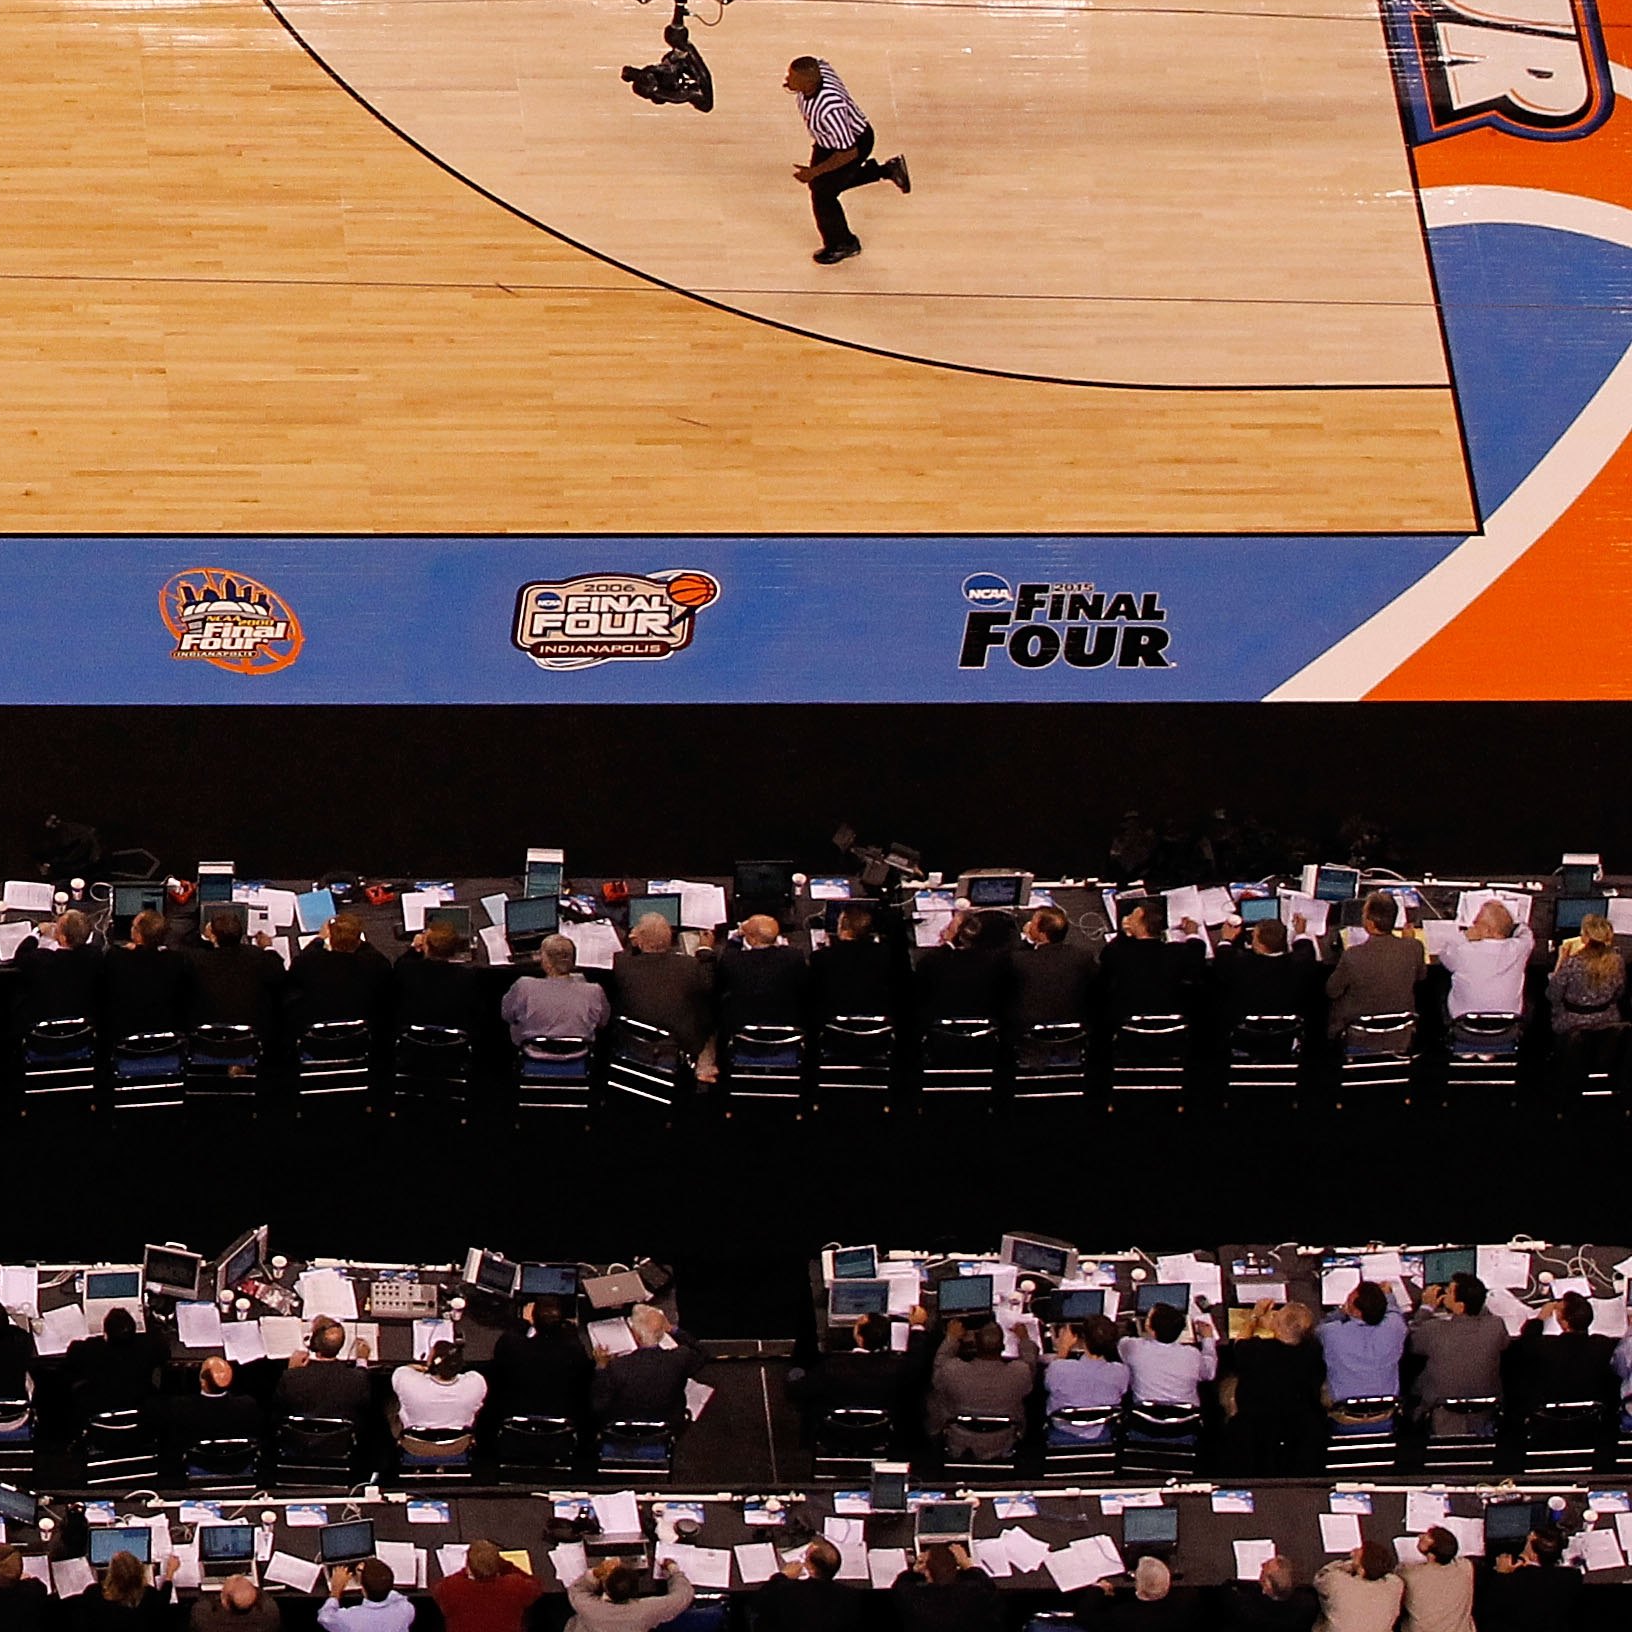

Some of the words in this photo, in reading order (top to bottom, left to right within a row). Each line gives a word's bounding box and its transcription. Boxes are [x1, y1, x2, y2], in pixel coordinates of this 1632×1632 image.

[583, 583, 636, 593] 2006
[967, 588, 1011, 601] NCAA
[567, 595, 670, 613] FINAL
[1012, 582, 1167, 623] FINAL
[201, 621, 287, 639] Final
[531, 612, 671, 636] FOUR
[958, 610, 1170, 669] FOUR
[539, 644, 661, 654] INDIANAPOLIS
